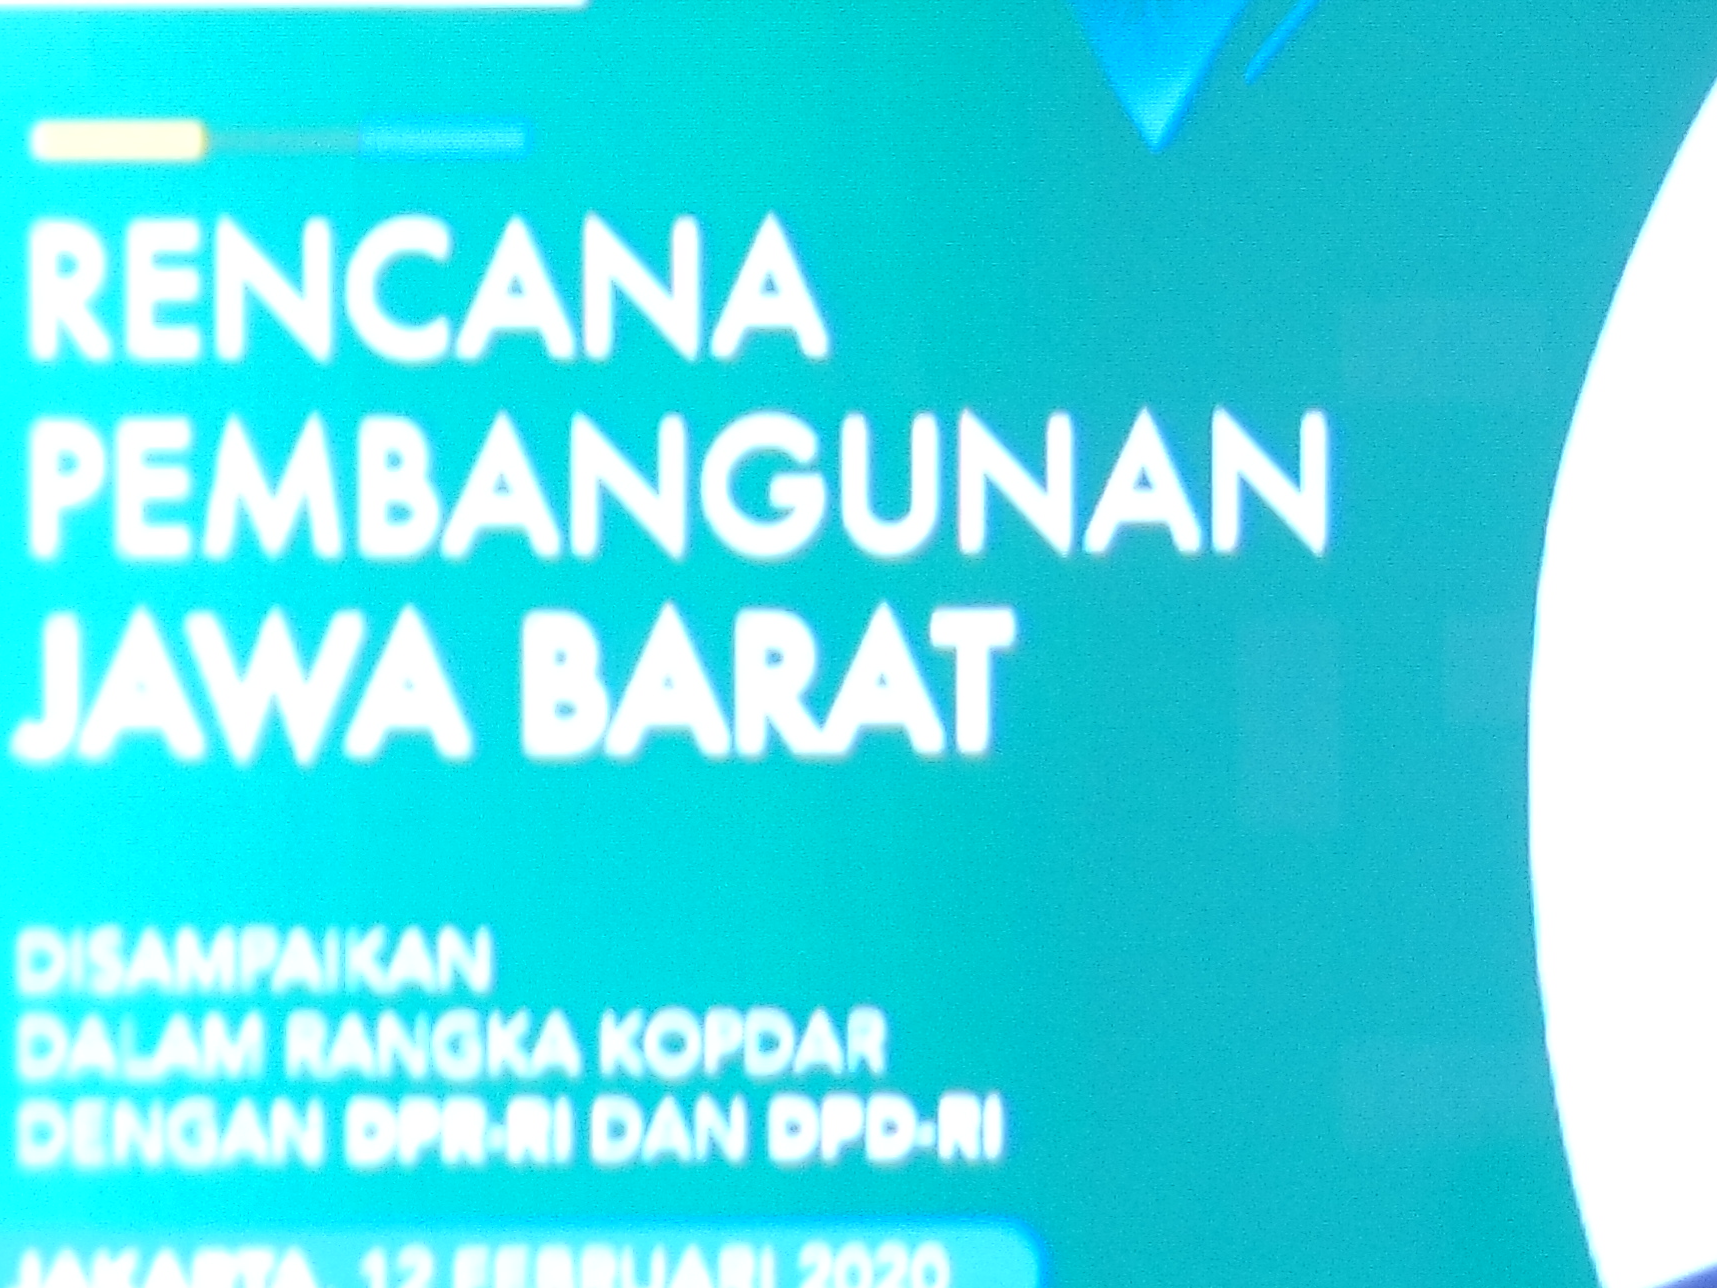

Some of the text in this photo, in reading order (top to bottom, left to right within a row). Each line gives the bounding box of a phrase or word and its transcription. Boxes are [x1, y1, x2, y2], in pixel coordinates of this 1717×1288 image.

[27, 209, 831, 363] RENCANA
[27, 406, 1329, 561] PEMBANGUNAN
[8, 601, 1018, 770] JAWA BARAT
[14, 925, 492, 996] DISAMPAIKAN
[14, 1005, 886, 1081] DALAM RANGKA KOPDAR
[14, 1092, 1004, 1169] DENGAN DPR-RI DAN DPD-RI
